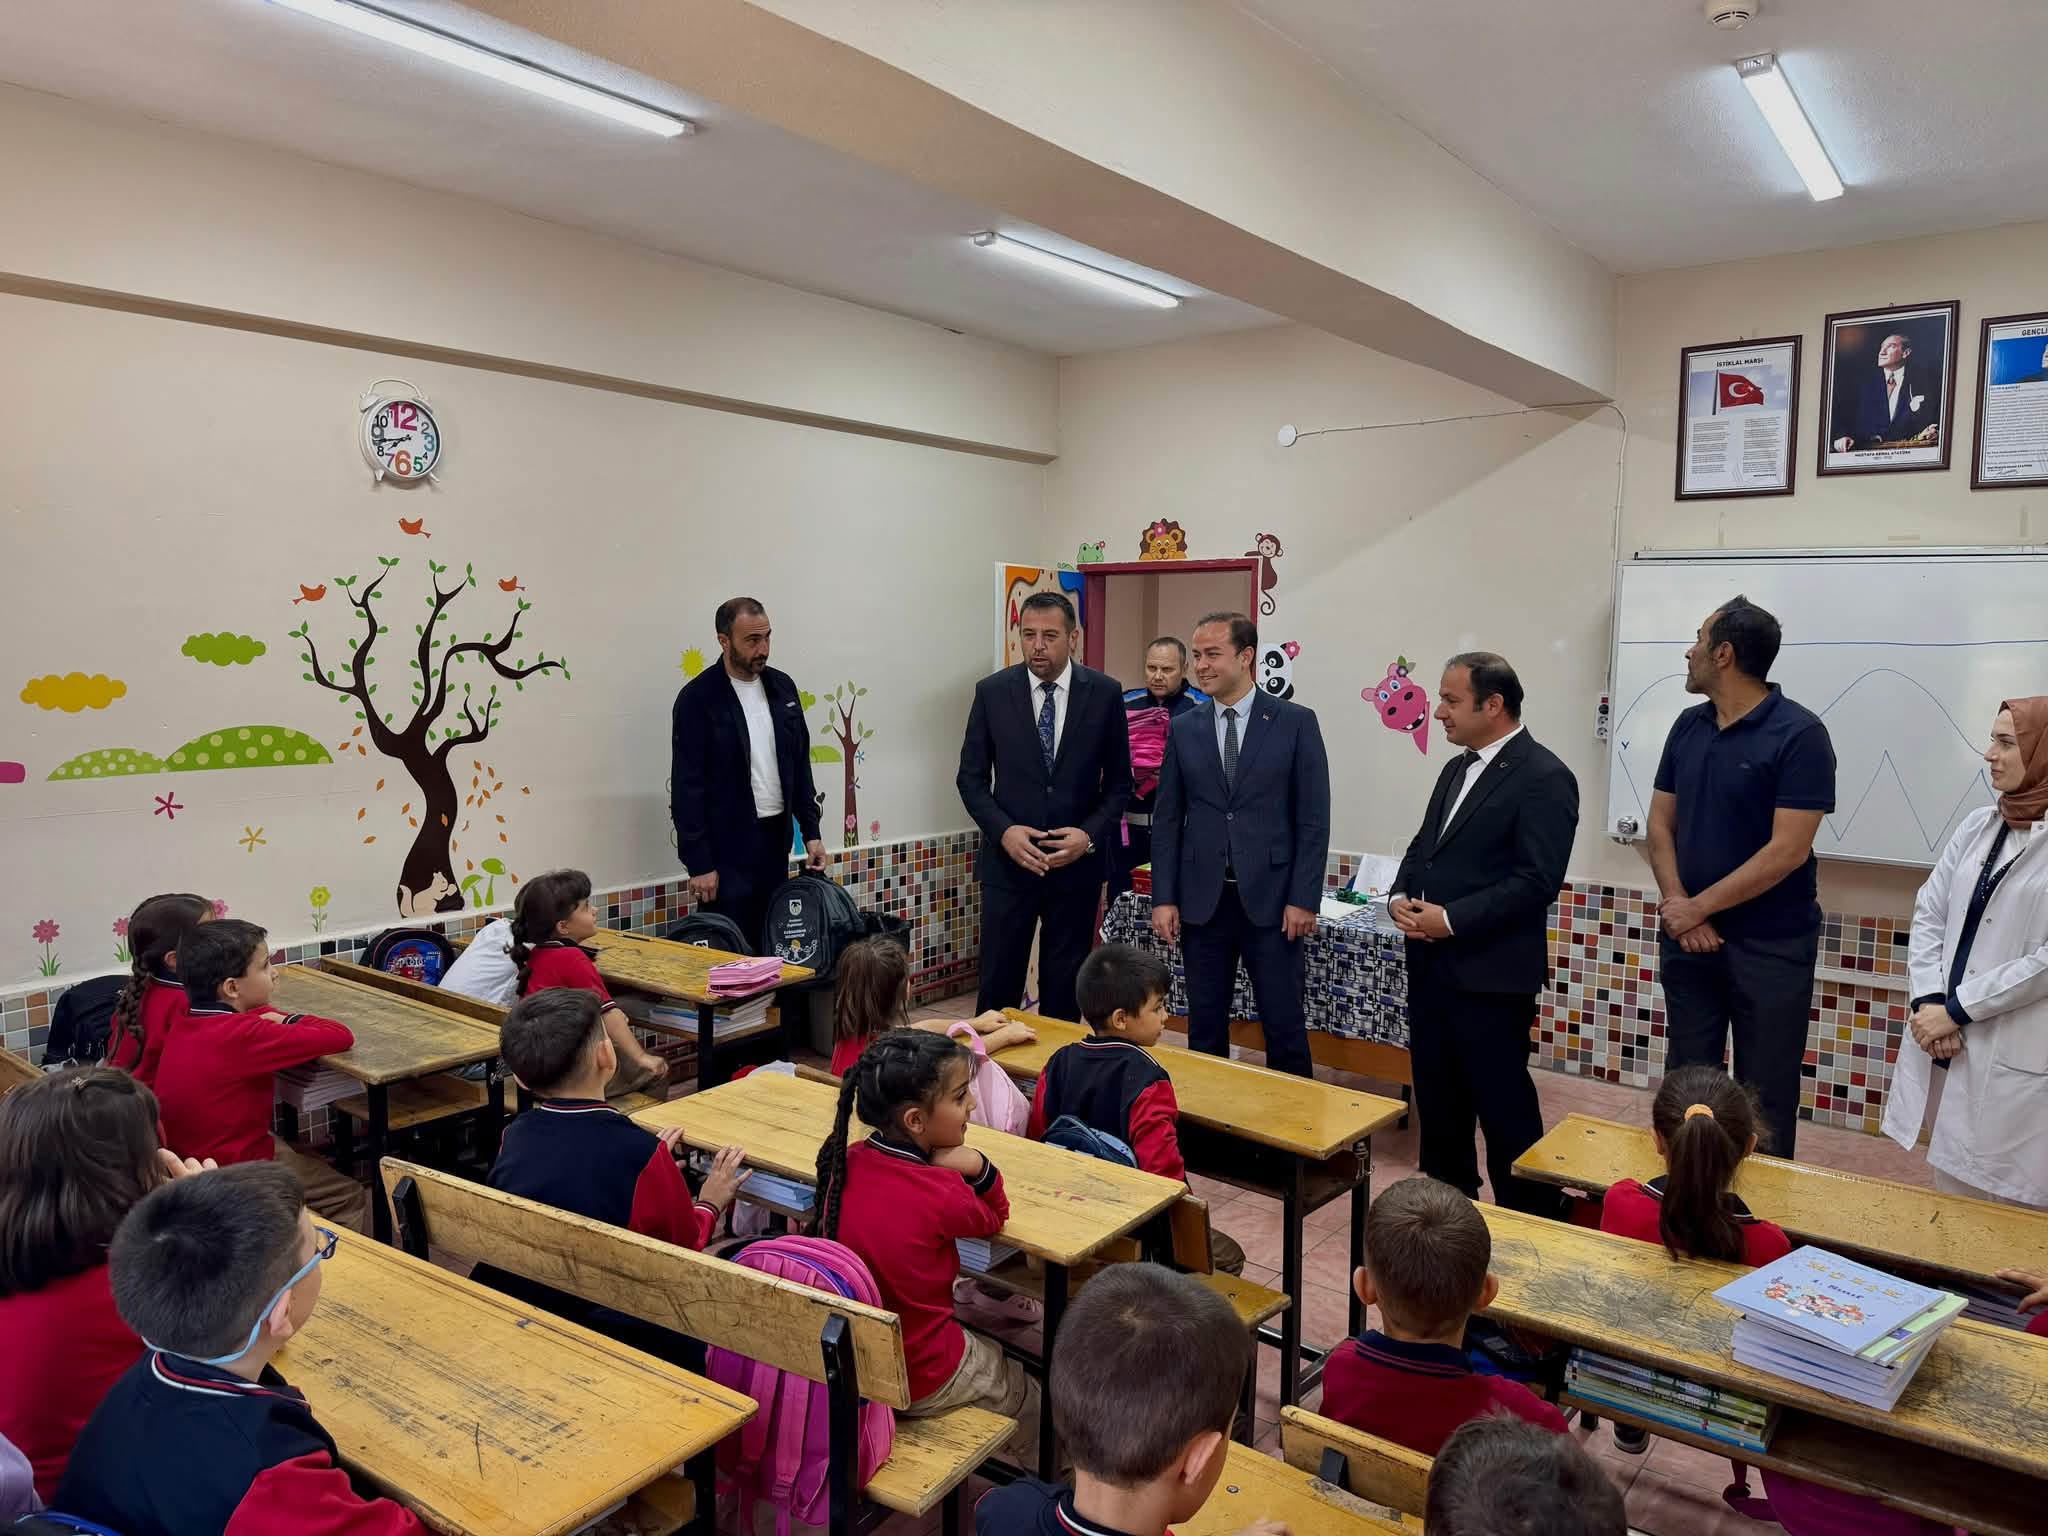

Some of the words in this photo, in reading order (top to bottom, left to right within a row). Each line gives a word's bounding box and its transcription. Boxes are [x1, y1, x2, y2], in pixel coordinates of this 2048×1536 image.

[375, 414, 388, 428] 10
[389, 401, 417, 431] 12
[421, 422, 430, 434] 2
[423, 433, 435, 452] 3
[377, 445, 385, 457] 8
[422, 451, 428, 460] 4
[385, 453, 395, 468] 7
[395, 450, 412, 475] 6
[413, 456, 424, 472] 5
